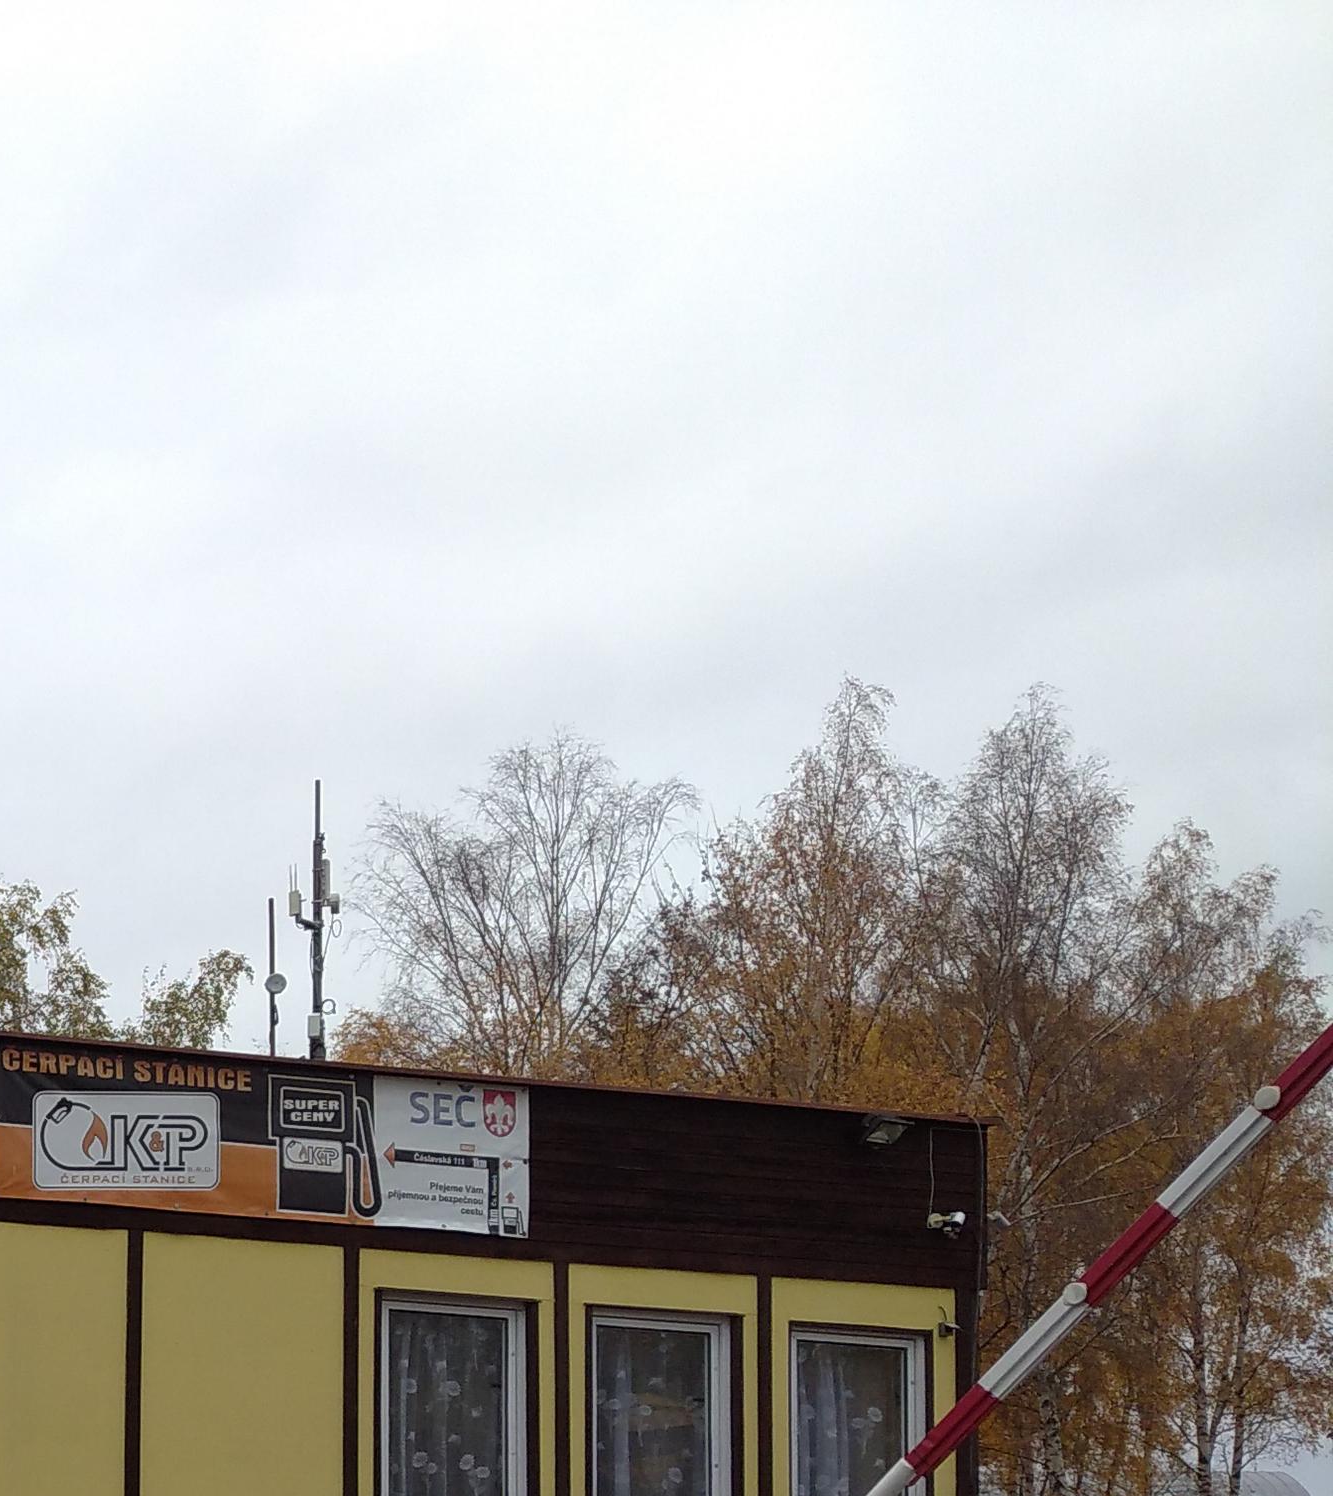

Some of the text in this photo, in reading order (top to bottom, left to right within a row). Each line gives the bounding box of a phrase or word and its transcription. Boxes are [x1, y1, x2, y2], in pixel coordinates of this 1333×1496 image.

[1, 1045, 252, 1092] ČERPACÍ STANICE
[284, 1099, 339, 1110] SUPER
[410, 1084, 475, 1128] SEČ
[291, 1111, 335, 1122] CENY
[60, 1172, 196, 1184] ČERPACÍ STANICE
